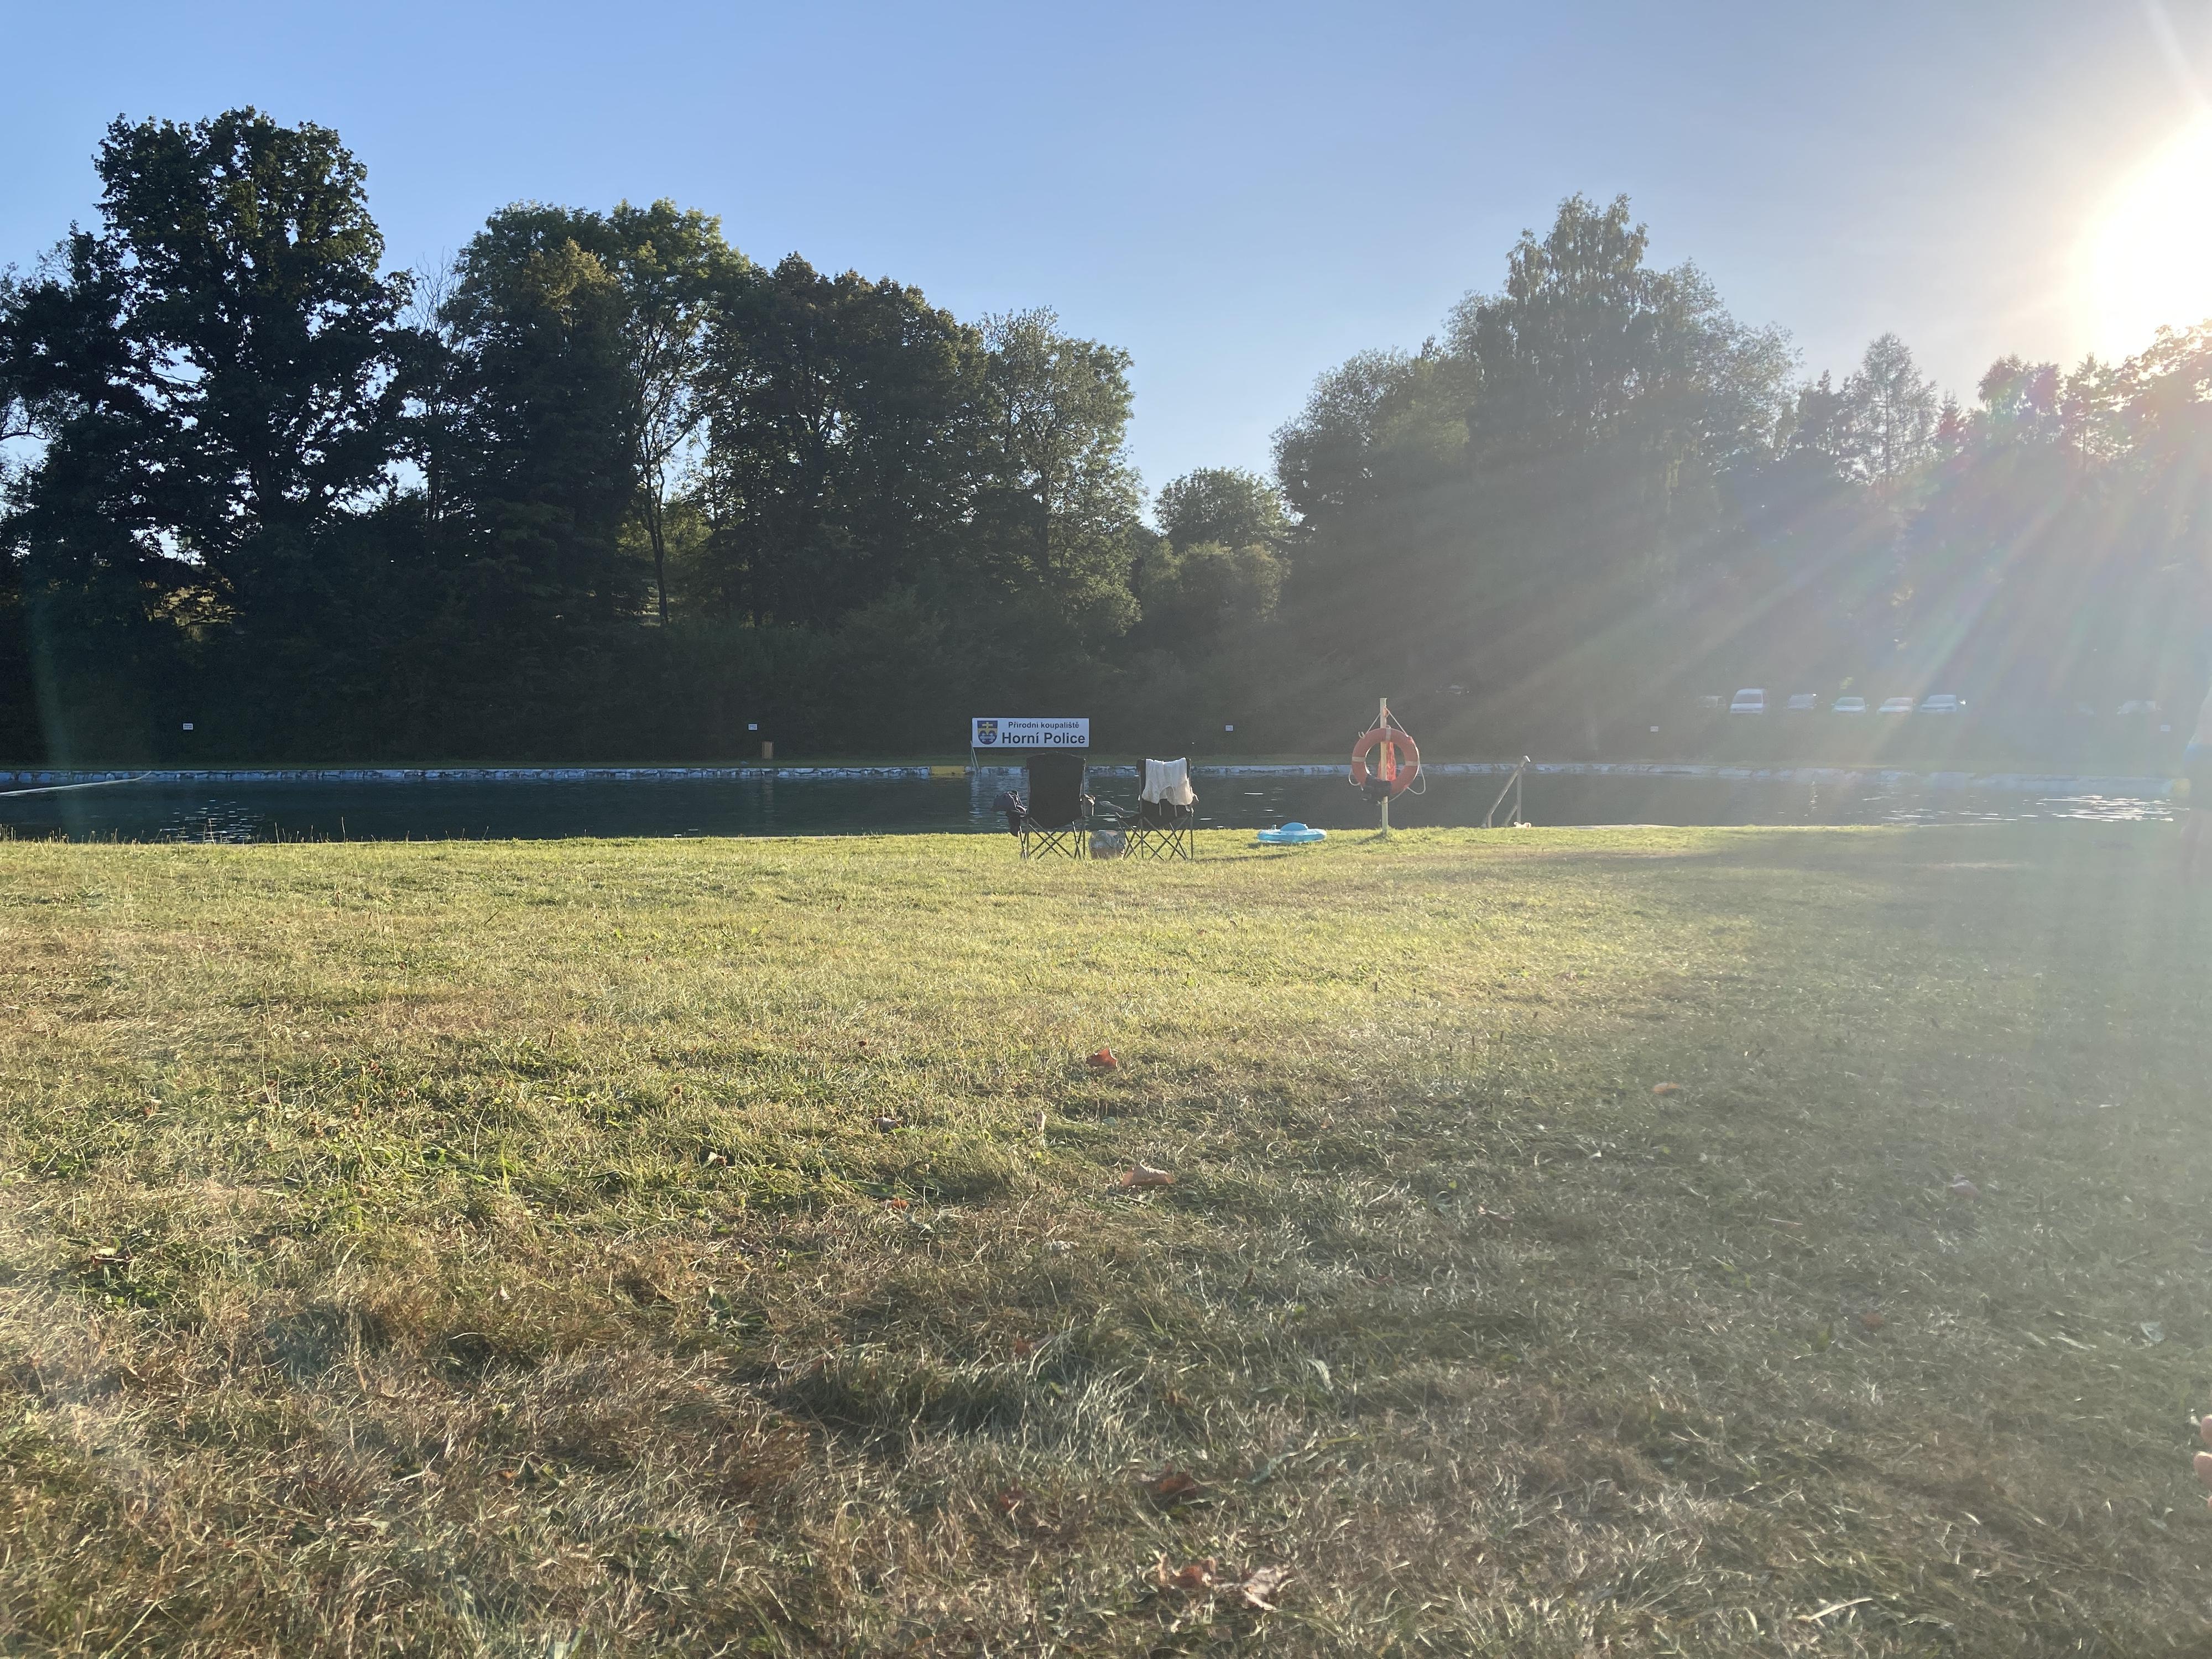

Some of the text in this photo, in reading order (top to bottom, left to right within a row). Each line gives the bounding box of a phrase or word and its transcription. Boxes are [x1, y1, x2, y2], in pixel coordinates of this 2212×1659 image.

[1041, 721, 1079, 729] koupaliště
[1002, 732, 1085, 744] Horní Police
